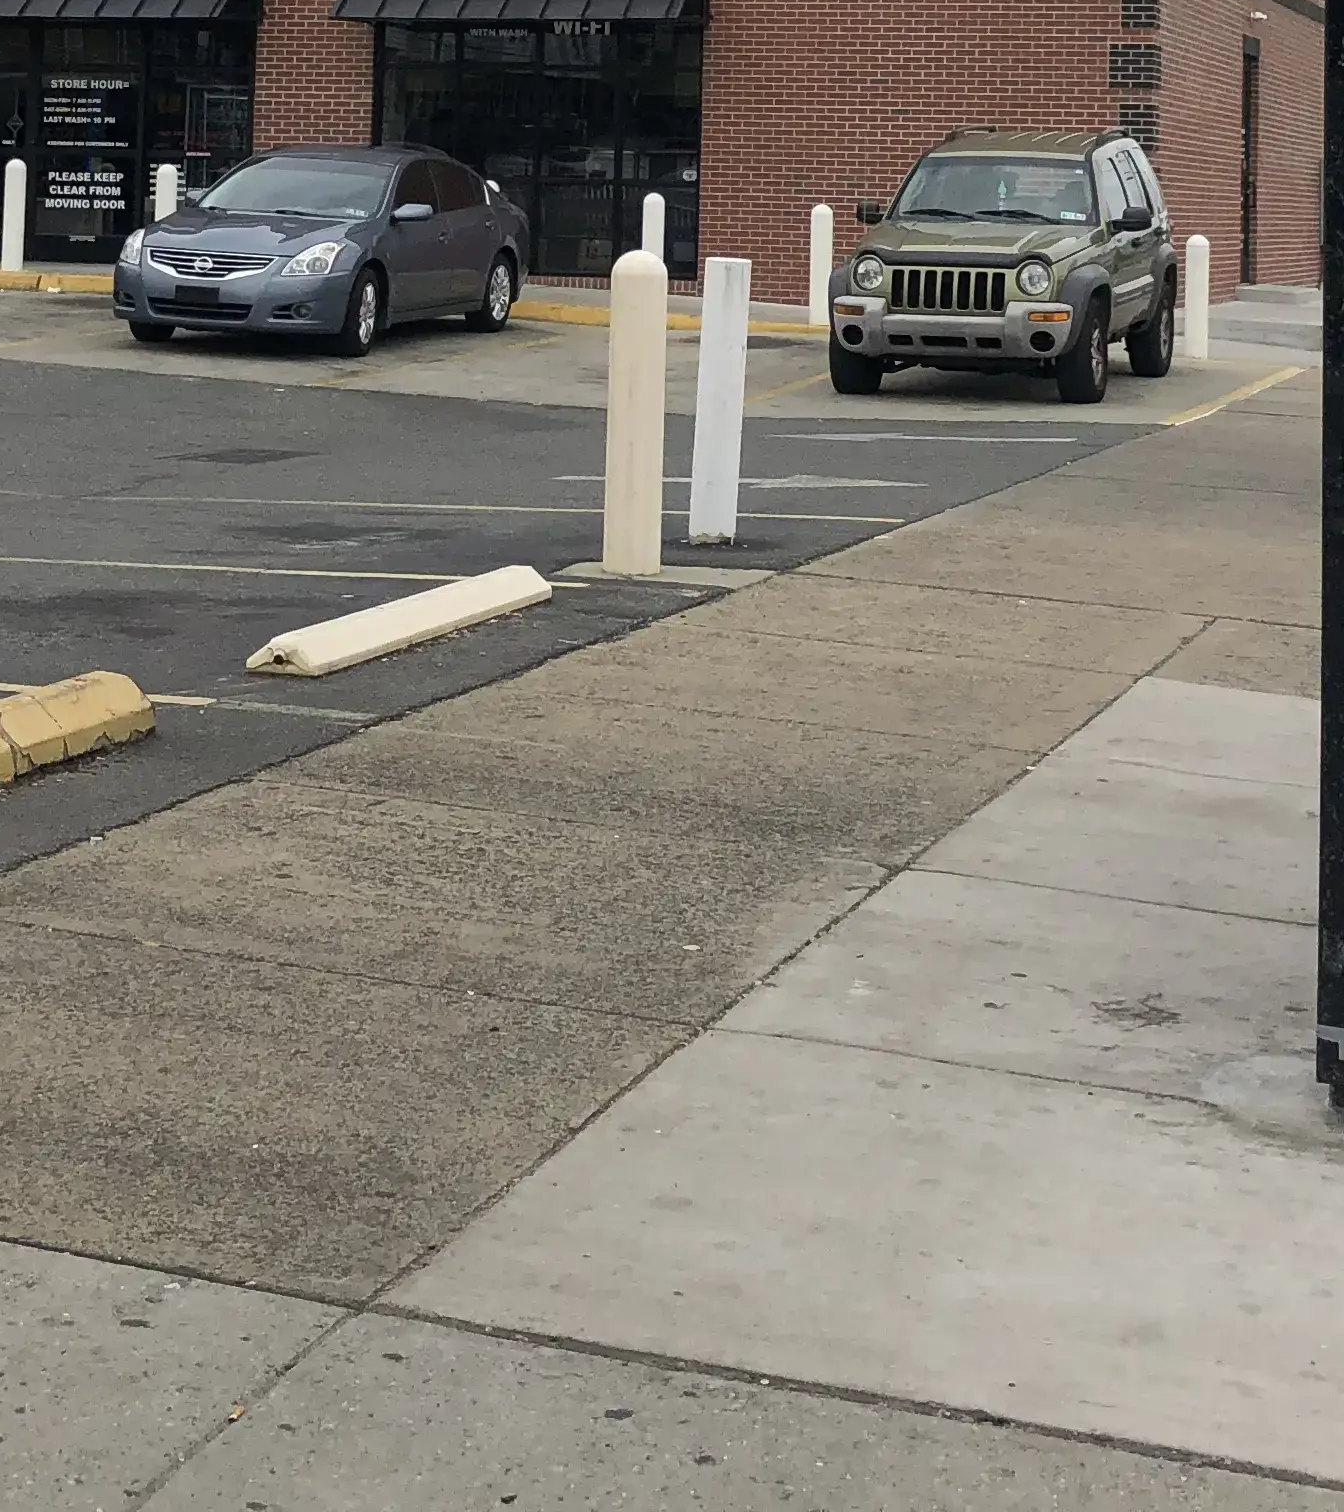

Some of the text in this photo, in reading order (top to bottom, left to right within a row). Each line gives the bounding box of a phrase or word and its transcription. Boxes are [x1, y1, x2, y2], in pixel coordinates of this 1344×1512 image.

[469, 28, 529, 37] WITH WASH
[50, 79, 88, 89] STORE
[48, 171, 124, 182] PLEASE KEEP
[49, 185, 121, 196] CLEAR FROM
[45, 198, 126, 210] MOVING DOOR
